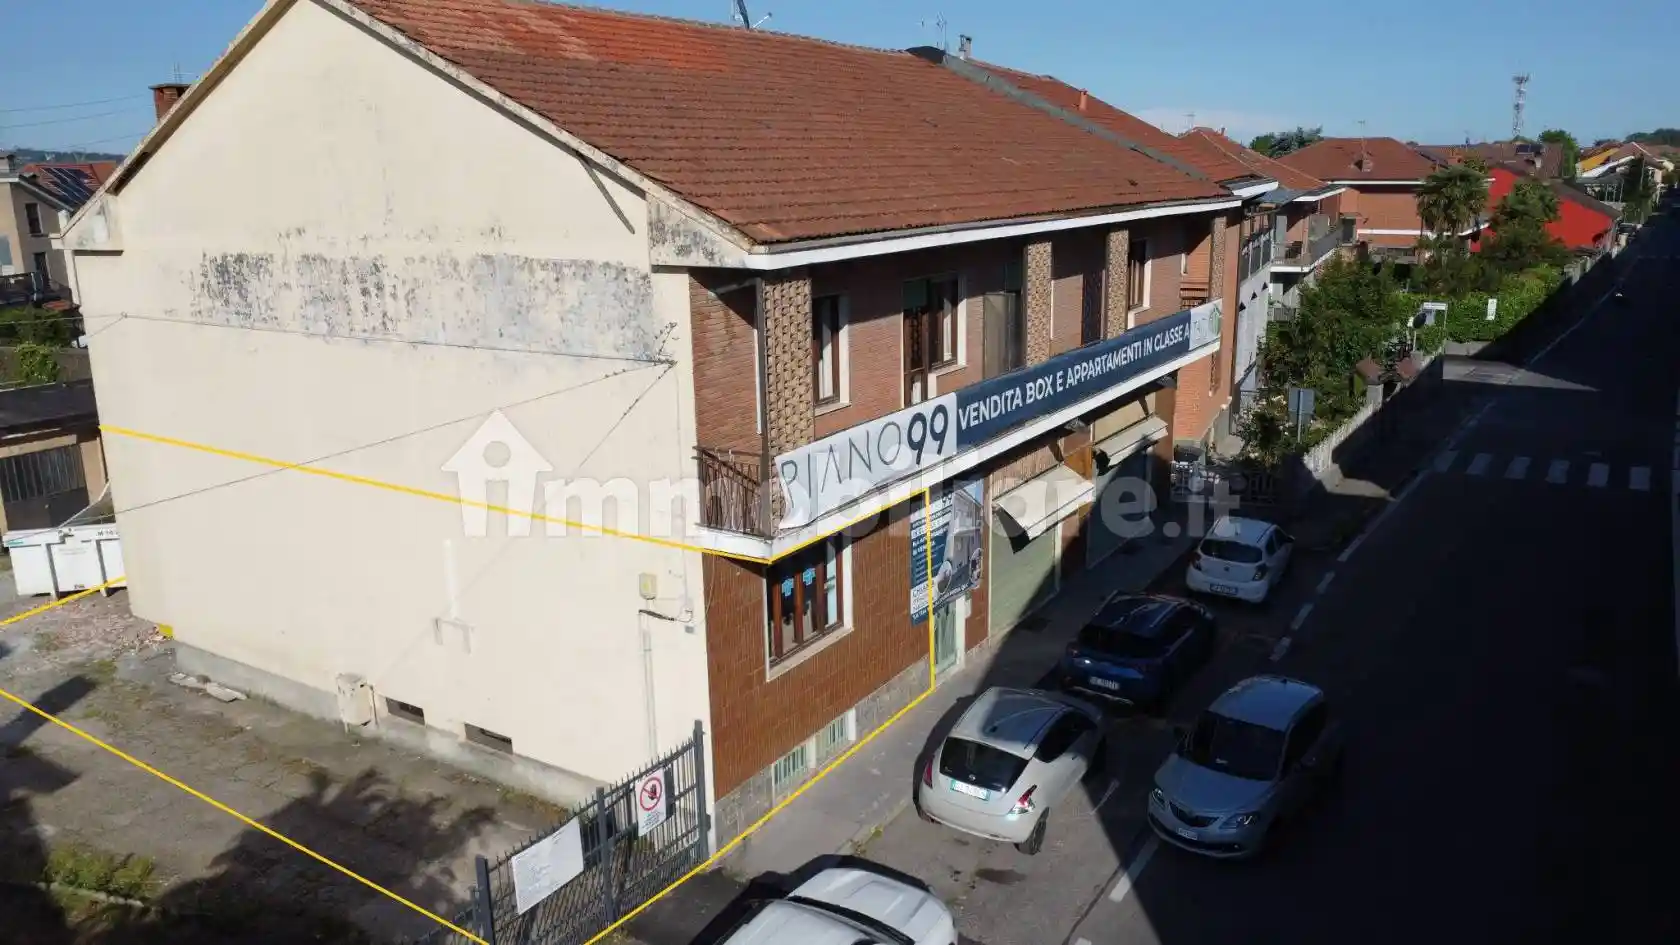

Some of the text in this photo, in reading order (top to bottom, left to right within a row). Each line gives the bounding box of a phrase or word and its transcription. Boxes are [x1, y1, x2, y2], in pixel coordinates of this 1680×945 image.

[958, 388, 1023, 430] VENDITA
[1026, 374, 1053, 402] BOX
[1056, 373, 1064, 393] E
[1065, 341, 1142, 389] APPARTAMENTI
[1143, 336, 1153, 356] IN
[1154, 324, 1183, 352] CLASSE
[781, 403, 949, 509] PIANO 99
